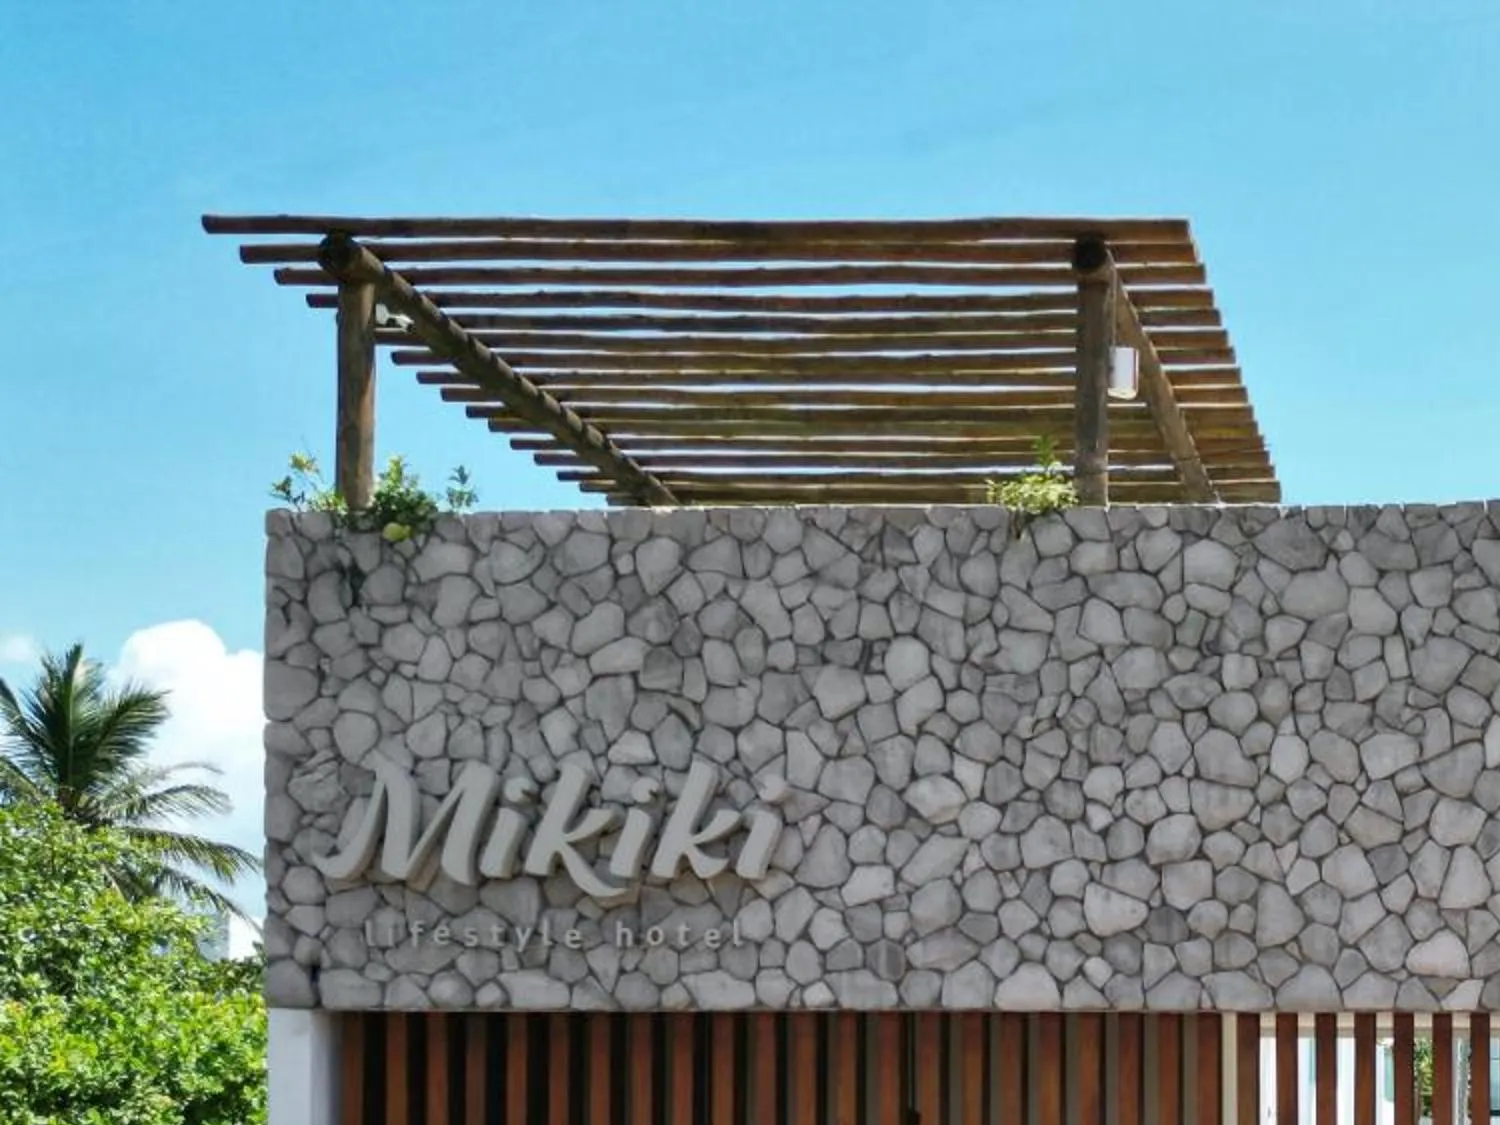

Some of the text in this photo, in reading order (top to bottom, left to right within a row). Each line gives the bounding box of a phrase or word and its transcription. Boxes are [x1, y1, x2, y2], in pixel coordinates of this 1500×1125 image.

[313, 754, 788, 899] Mikiki
[364, 918, 745, 952] lifestyle hotel
